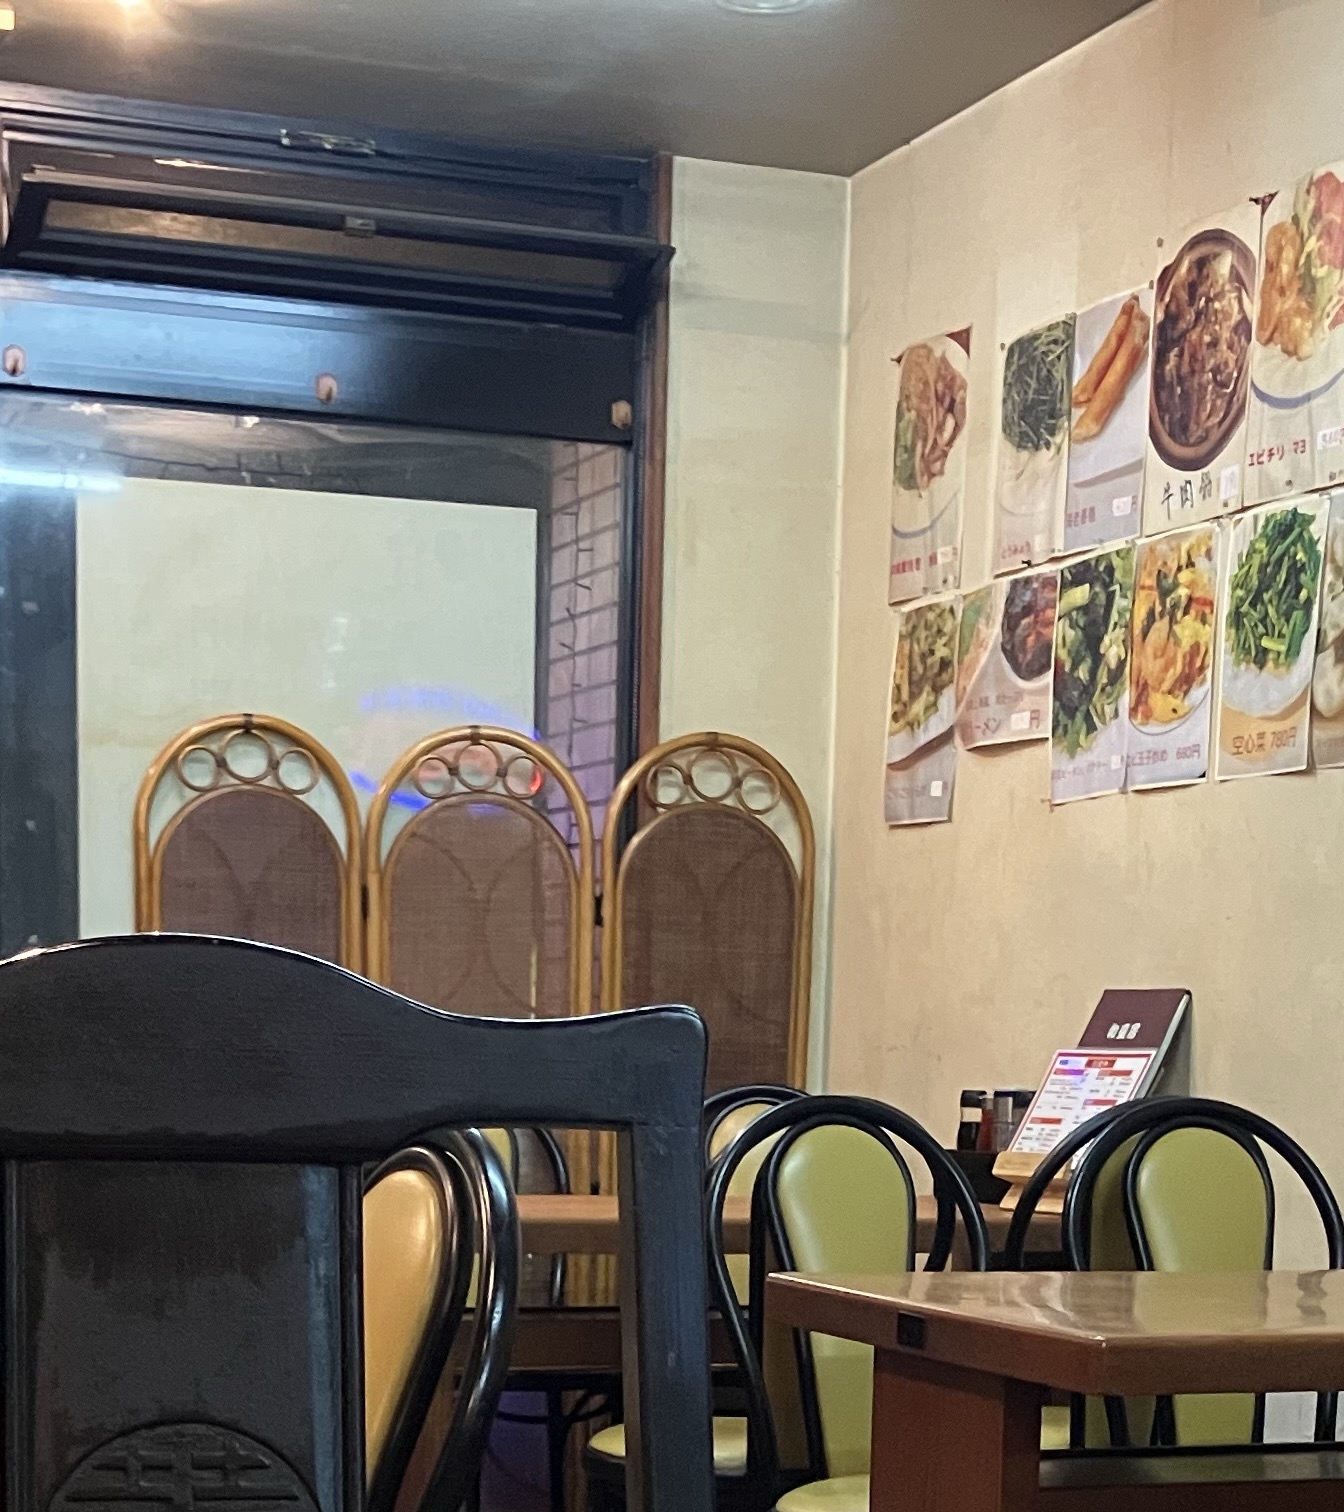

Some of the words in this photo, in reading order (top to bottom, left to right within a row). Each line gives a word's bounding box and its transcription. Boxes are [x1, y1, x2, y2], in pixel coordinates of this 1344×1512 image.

[1248, 445, 1285, 467] エビチリ
[1231, 732, 1267, 757] 空心菜
